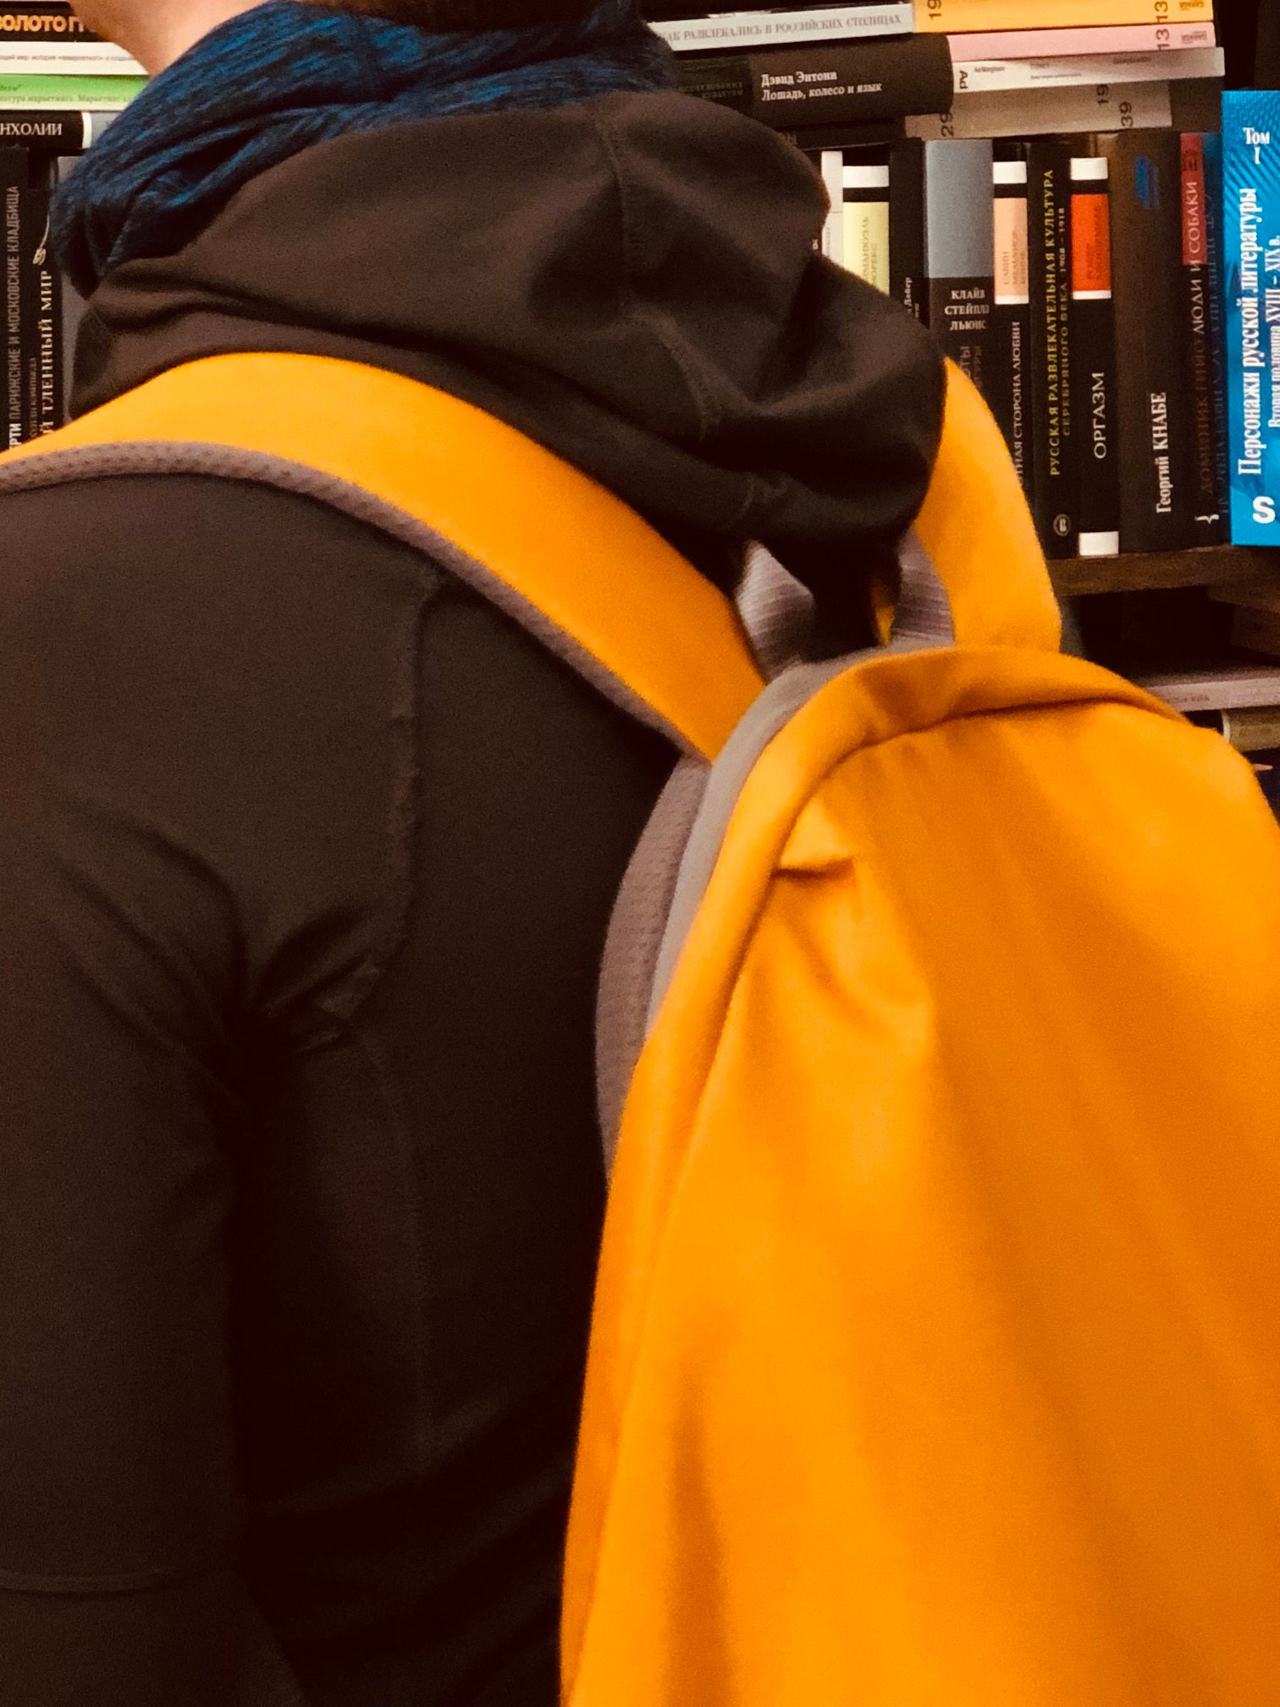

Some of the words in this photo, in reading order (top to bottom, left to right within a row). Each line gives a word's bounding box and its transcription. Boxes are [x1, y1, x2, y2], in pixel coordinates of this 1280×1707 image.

[1243, 128, 1270, 145] Том
[1238, 188, 1258, 295] литературы
[1236, 298, 1263, 367] русской
[1093, 371, 1106, 460] ОРГАЗМ
[1238, 370, 1262, 475] Персонажи
